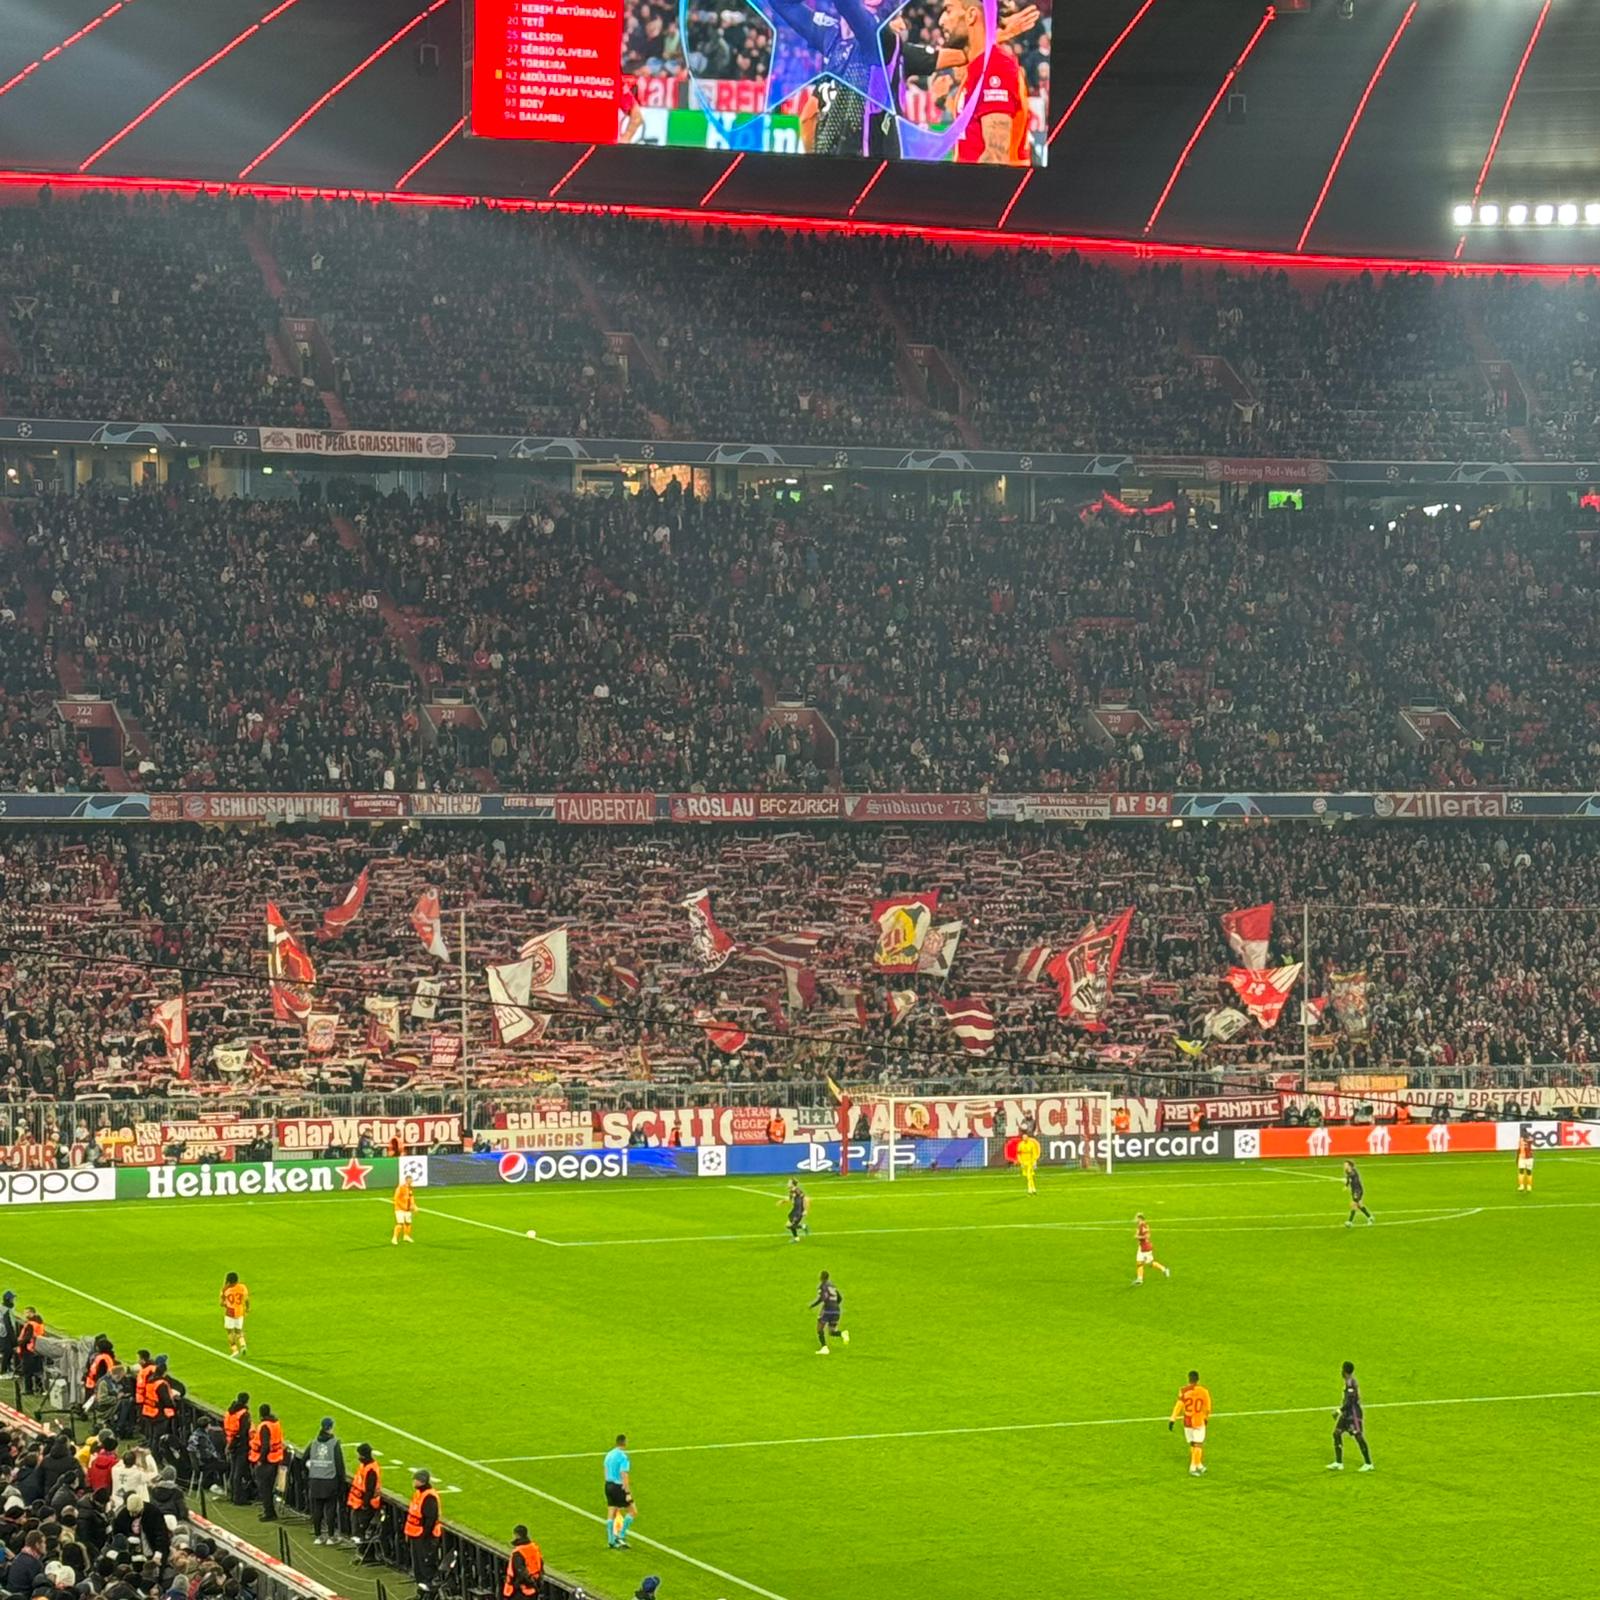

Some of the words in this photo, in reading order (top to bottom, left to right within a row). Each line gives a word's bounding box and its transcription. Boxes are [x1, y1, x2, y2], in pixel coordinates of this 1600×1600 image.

[296, 433, 322, 449] ROTE
[325, 433, 357, 451] PERLE
[358, 435, 423, 453] GRASSLFING
[210, 797, 340, 817] SCHLOSSPANTHER
[557, 798, 651, 821] TAUBERTAL
[687, 795, 754, 817] RÖSLAU
[759, 799, 787, 814] BFC
[1116, 796, 1139, 812] AF
[1145, 796, 1169, 812] 94
[424, 1114, 461, 1143] rot
[1519, 1120, 1592, 1148] FedEx
[122, 1145, 157, 1163] RED
[1049, 1131, 1219, 1161] mastercard
[534, 1147, 628, 1183] pepsi
[0, 1171, 99, 1202] ppo
[146, 1162, 334, 1198] Heineken
[1184, 1397, 1204, 1413] 20
